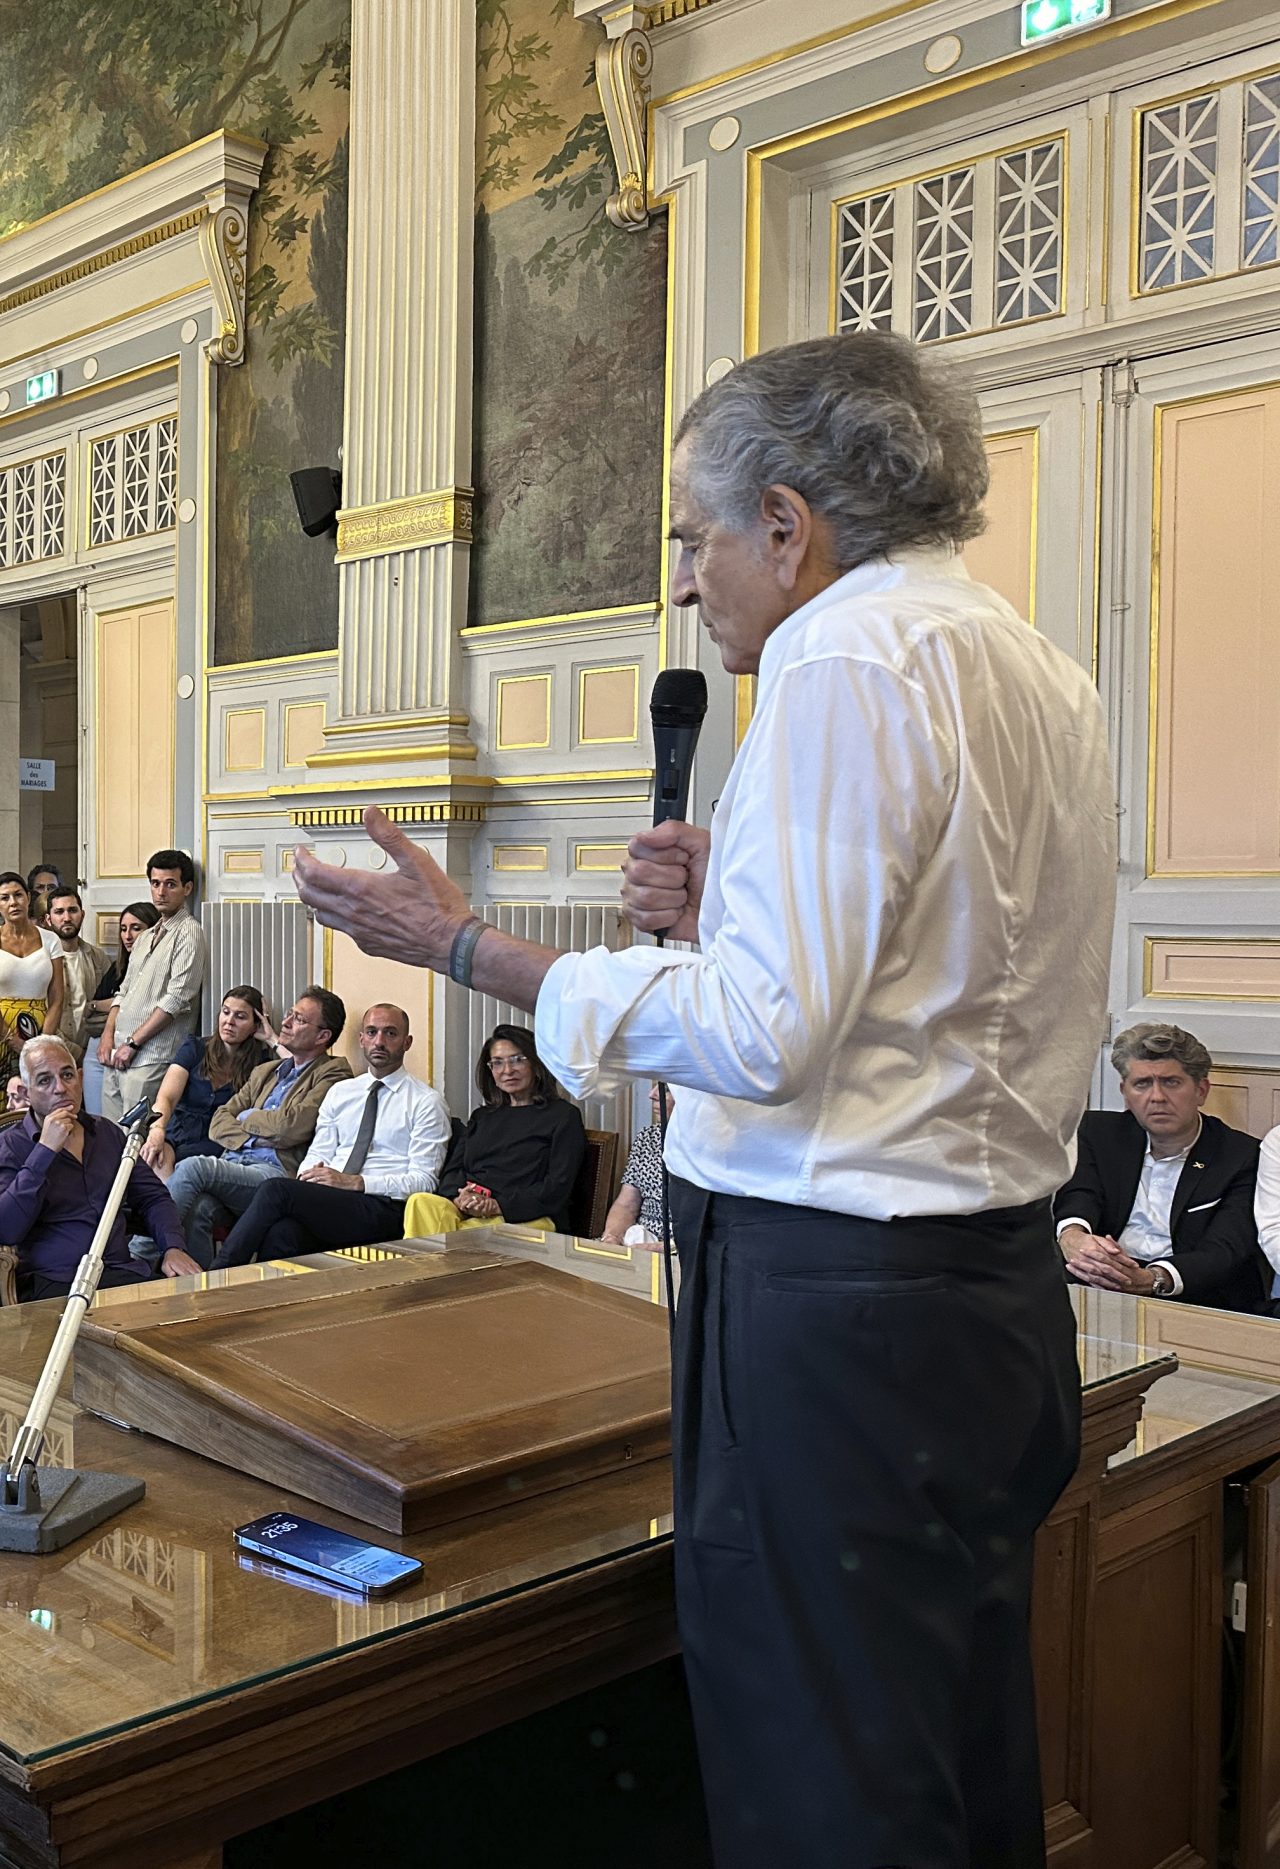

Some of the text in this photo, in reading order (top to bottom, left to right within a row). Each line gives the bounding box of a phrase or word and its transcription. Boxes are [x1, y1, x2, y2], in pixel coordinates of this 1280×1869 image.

[26, 761, 41, 769] SALLE
[29, 770, 39, 778] des
[261, 1521, 298, 1538] 21:35
